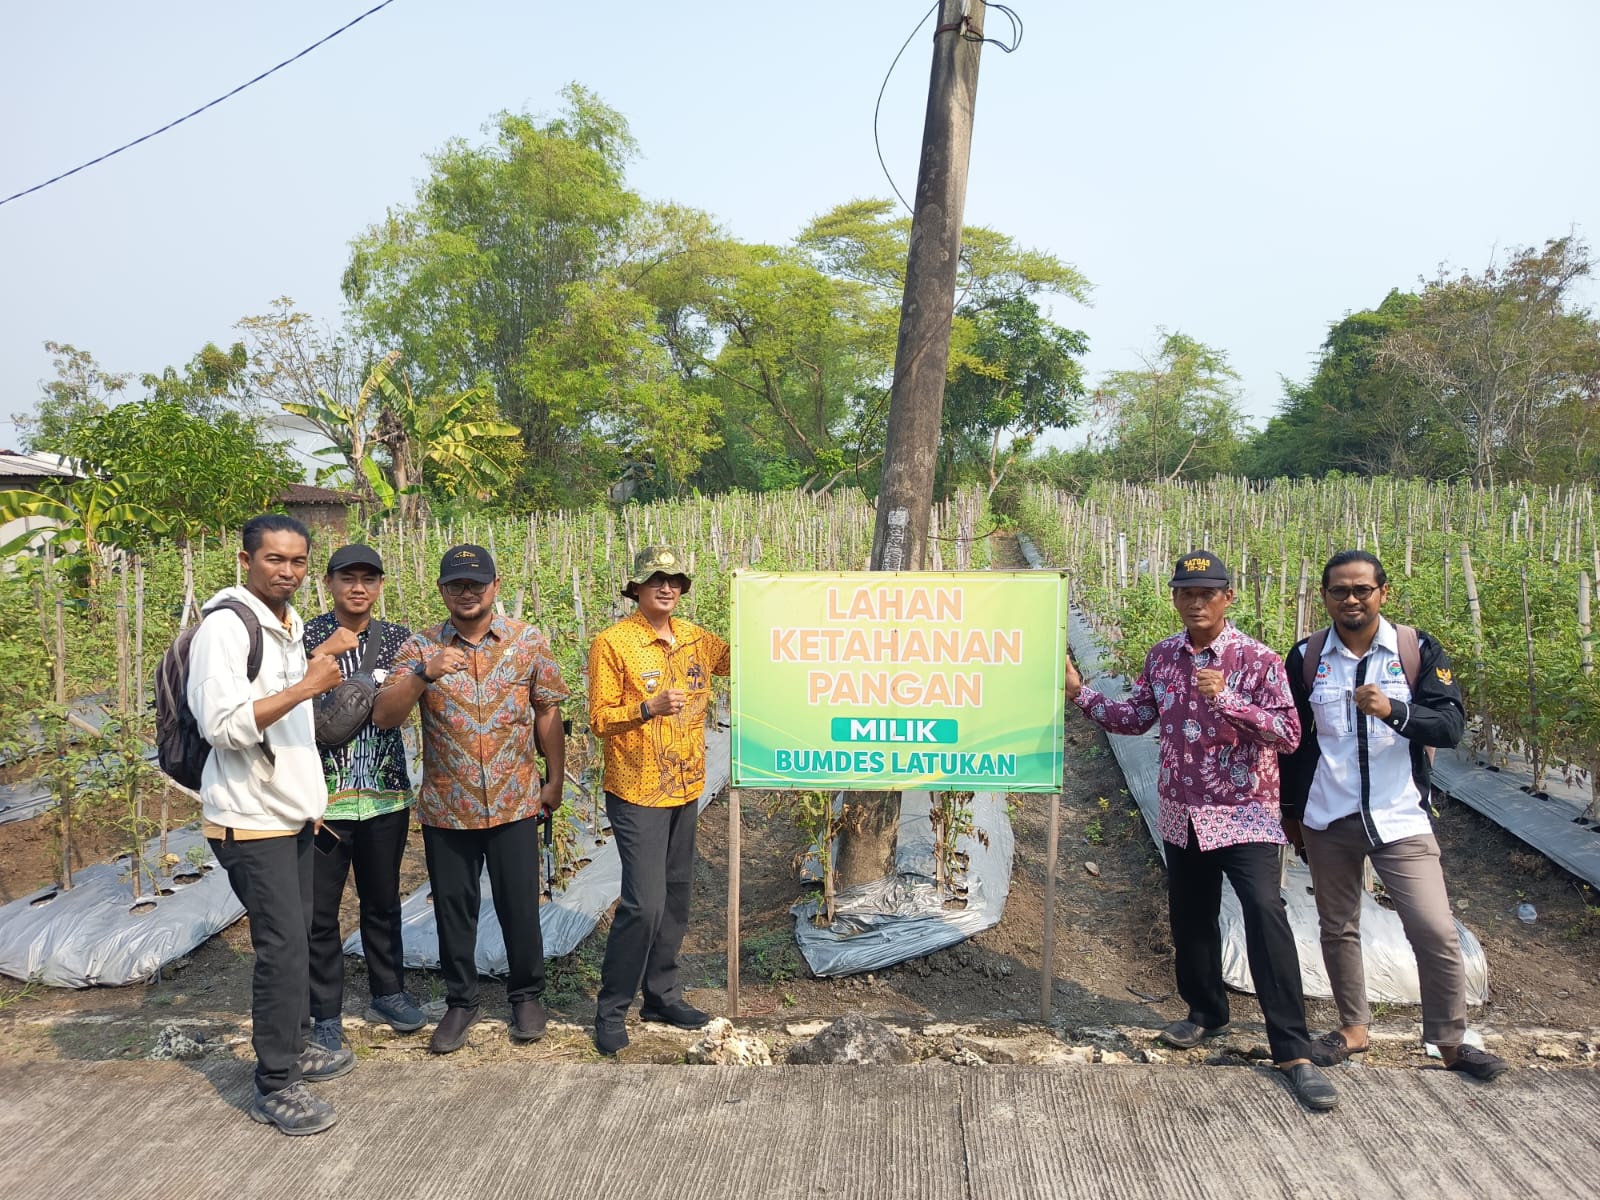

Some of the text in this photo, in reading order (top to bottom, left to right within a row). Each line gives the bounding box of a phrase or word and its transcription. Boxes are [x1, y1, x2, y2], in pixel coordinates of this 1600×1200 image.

[828, 588, 963, 621] LAHAN
[771, 629, 1022, 664] KETAHANAN
[808, 672, 982, 706] PANGAN
[850, 719, 938, 743] MILIK
[775, 750, 1016, 776] BUMDES LATUKAN
